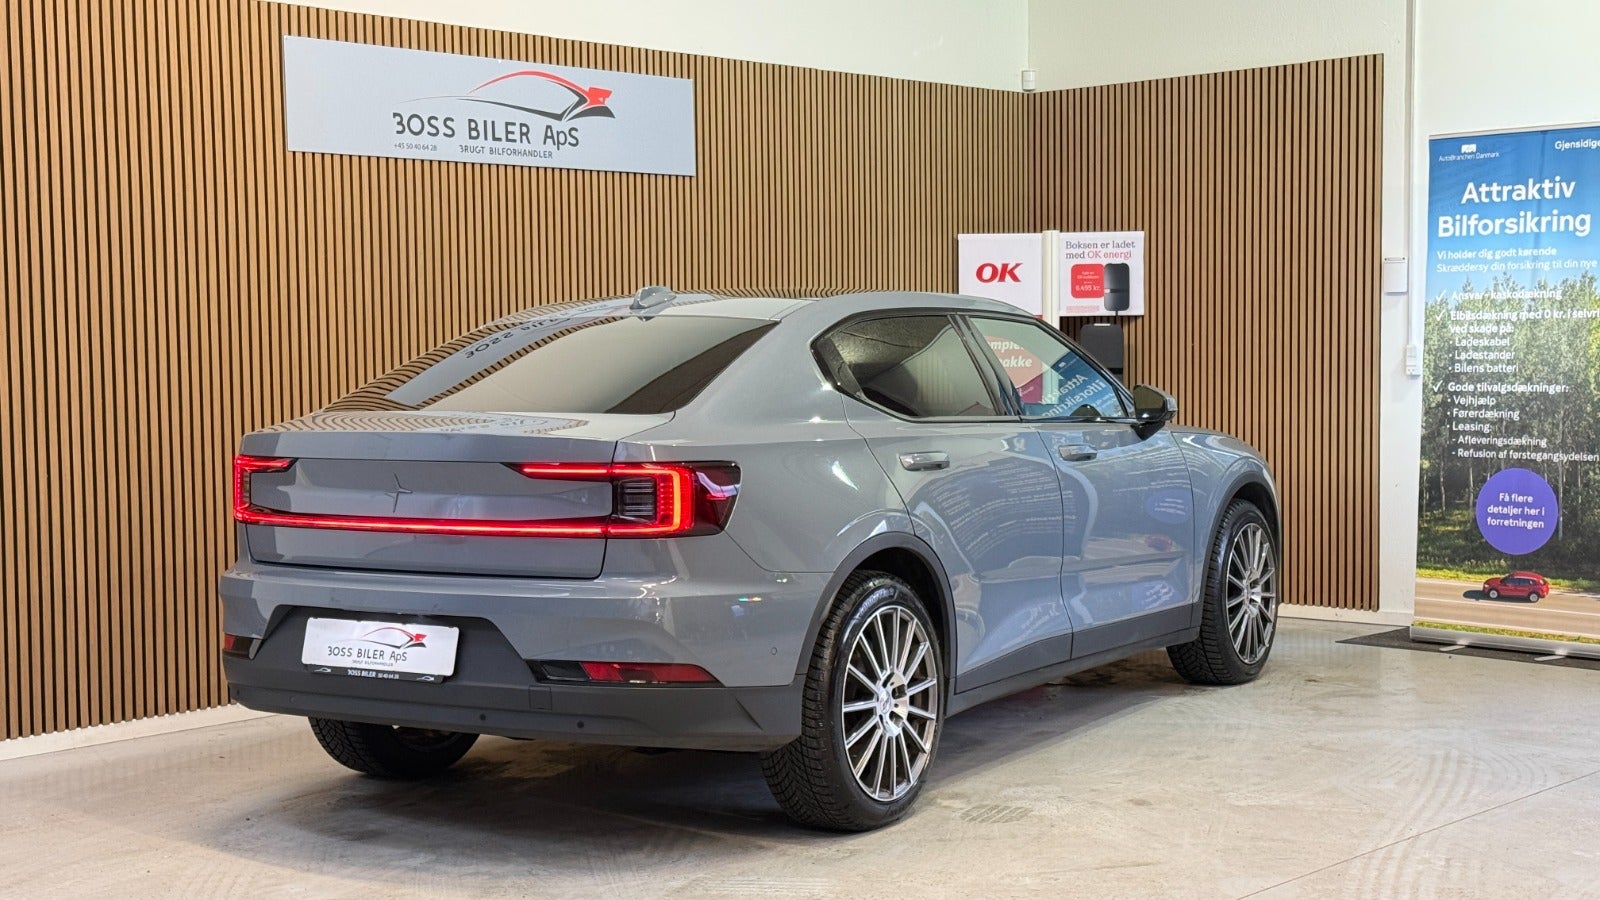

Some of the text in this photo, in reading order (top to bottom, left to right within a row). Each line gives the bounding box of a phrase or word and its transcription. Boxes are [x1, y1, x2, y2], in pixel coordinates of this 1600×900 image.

[468, 119, 531, 144] BILER
[543, 125, 580, 150] ApS
[489, 146, 552, 159] BILFORHANDLER
[1461, 176, 1576, 204] Attraktiv
[1438, 210, 1591, 237] Bilforsikring
[1066, 241, 1098, 249] Boksen
[1088, 251, 1102, 259] OK
[1104, 250, 1132, 260] energi
[1437, 247, 1557, 260] Vi holder dig godt kørende
[1437, 259, 1597, 273] Skræddersy din forsikring til din nye
[976, 262, 1023, 283] OK
[1520, 310, 1542, 319] med
[1553, 309, 1565, 318] kr.
[1449, 324, 1514, 336] ved skade på:
[1455, 337, 1510, 346] Ladeskabel
[999, 355, 1032, 367] akke
[1454, 350, 1515, 360] Ladestander
[1454, 363, 1519, 373] Bilens batteri
[1448, 383, 1569, 394] Gode tilvalgsdækninger:
[1453, 395, 1496, 406] Vejhjælp
[1453, 409, 1520, 421] Førerdækning
[1452, 422, 1492, 433] Leasing:
[1457, 436, 1547, 447] Afleveringsdækning
[1458, 449, 1599, 463] Refusion af førstegangsydelsen
[1499, 493, 1533, 503] Få flere
[1487, 505, 1522, 516] detaljer
[1524, 507, 1540, 515] her
[1487, 516, 1544, 529] forretningen
[357, 648, 385, 660] BILER
[389, 651, 408, 663] ApS
